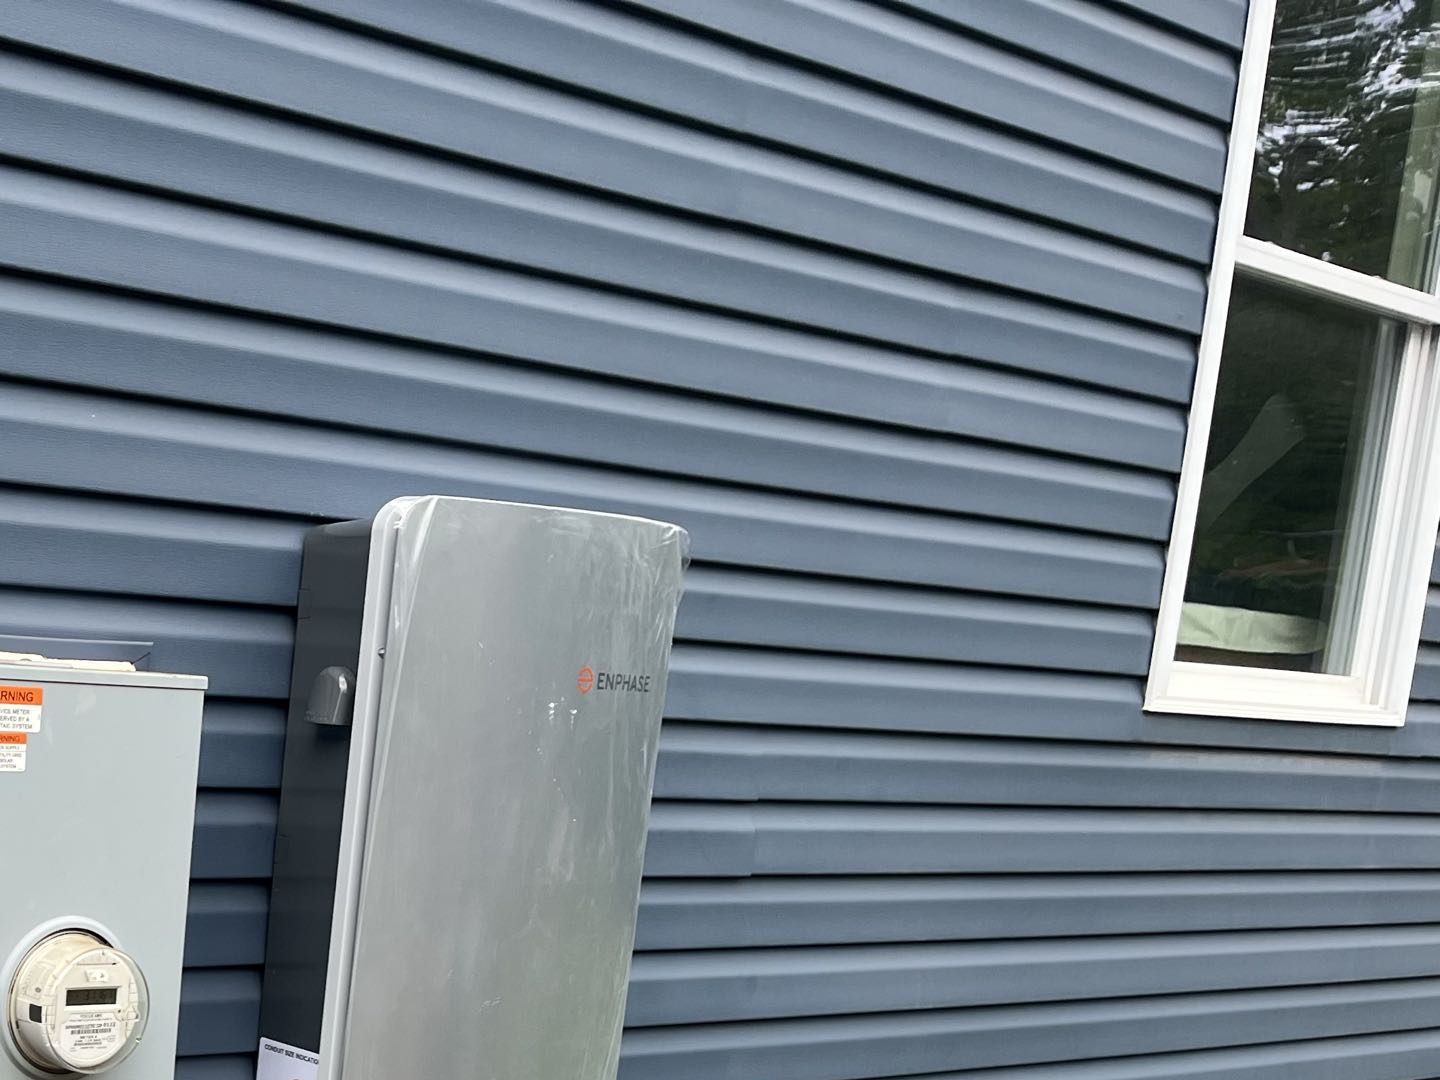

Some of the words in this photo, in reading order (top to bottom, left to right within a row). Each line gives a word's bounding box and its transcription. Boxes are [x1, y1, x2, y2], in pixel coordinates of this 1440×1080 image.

[597, 672, 651, 692] ENPHASE
[264, 1043, 284, 1054] CONDUIT
[285, 1049, 295, 1058] SIZE
